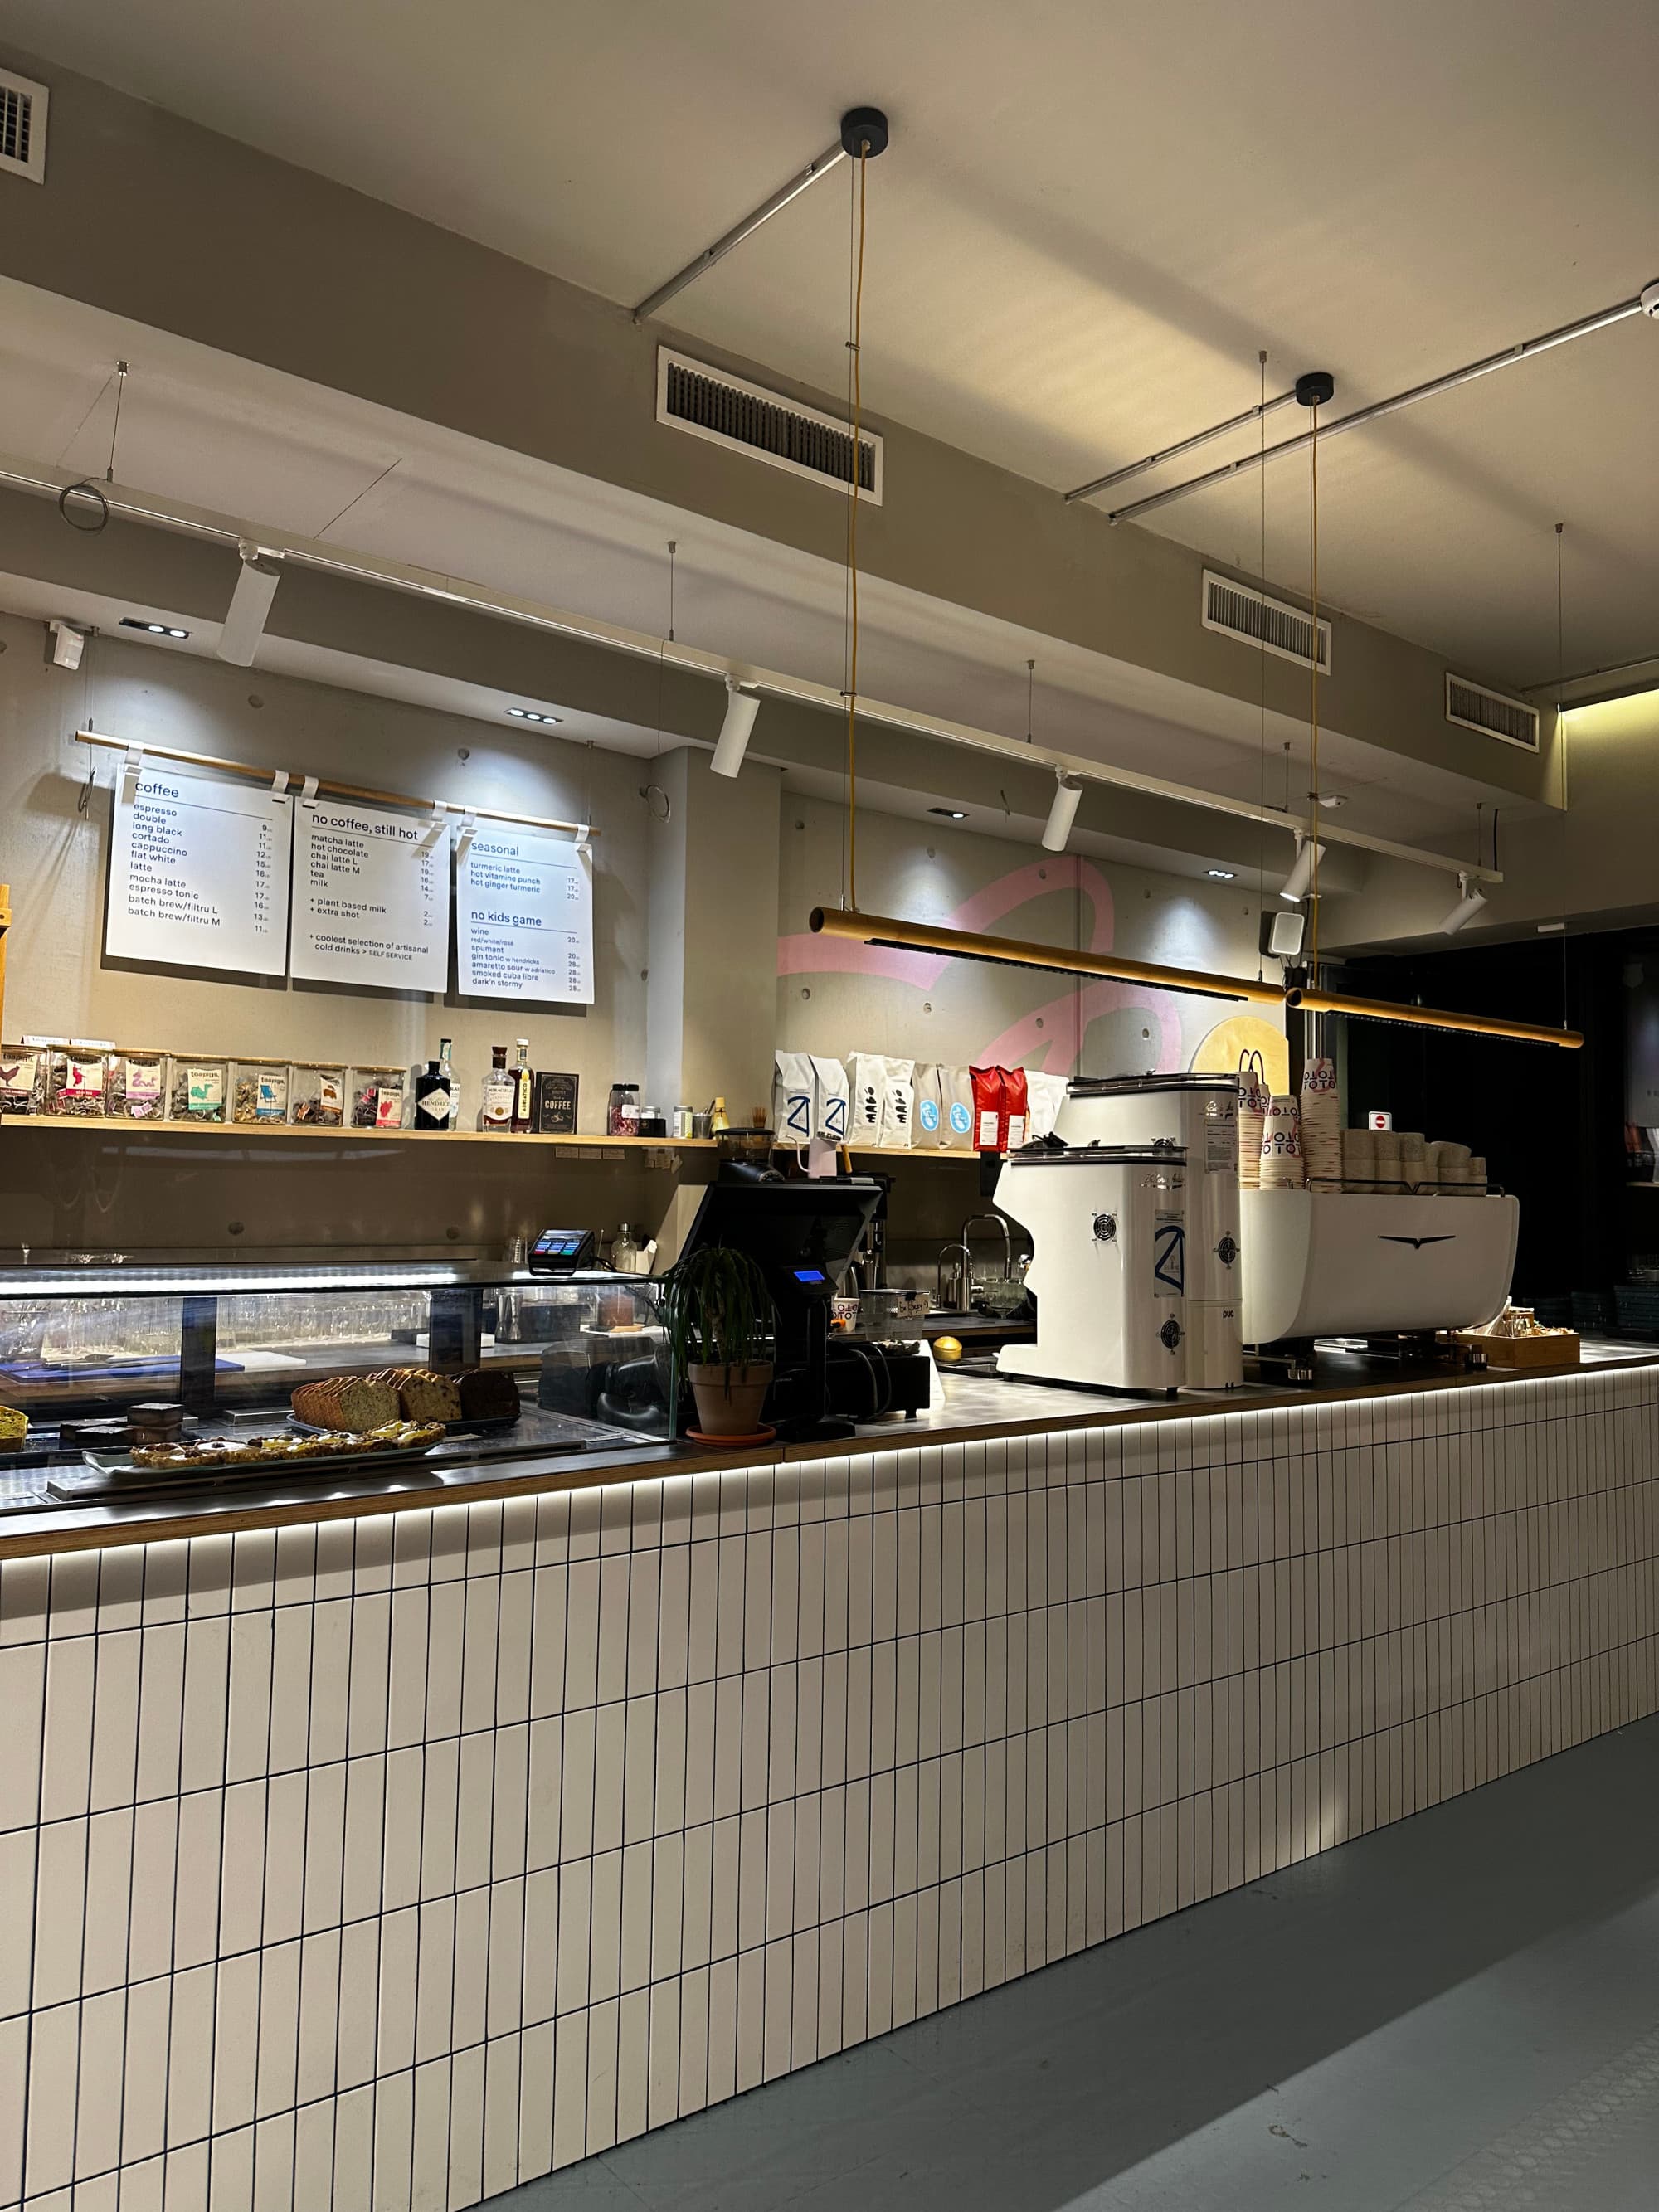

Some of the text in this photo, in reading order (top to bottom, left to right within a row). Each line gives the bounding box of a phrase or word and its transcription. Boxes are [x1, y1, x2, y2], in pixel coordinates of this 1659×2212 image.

[135, 782, 179, 798] coffee
[134, 803, 177, 816] espresso
[133, 812, 166, 824] double
[132, 821, 153, 834] long
[157, 825, 182, 836] black
[312, 814, 418, 840] no coffee, still hot
[132, 831, 169, 843] cortado
[312, 834, 343, 845] matcha
[345, 838, 364, 848] latte
[131, 842, 187, 856] cappuccino
[311, 843, 325, 852] hot
[327, 845, 369, 858] chocolate
[471, 842, 519, 856] seasonal
[131, 850, 147, 860] flat
[149, 853, 176, 864] white
[311, 852, 328, 861] chai
[331, 854, 350, 864] latte
[130, 862, 153, 872] latte
[311, 860, 328, 870] chai
[331, 863, 350, 873] latte
[470, 862, 502, 873] turmeric
[504, 866, 520, 874] latte
[129, 874, 162, 885] mocha
[164, 878, 187, 888] latte
[310, 878, 328, 887] milk
[484, 873, 516, 882] vitamine
[518, 877, 541, 885] punch
[129, 884, 173, 896] espresso
[175, 890, 199, 900] tonic
[484, 880, 508, 890] ginger
[510, 883, 541, 893] turmeric
[129, 895, 156, 906] batch
[158, 898, 209, 914] brew/filtru
[212, 906, 218, 914] L
[317, 897, 339, 907] plant
[342, 900, 367, 911] based
[369, 905, 387, 914] milk
[128, 907, 155, 917] batch
[158, 910, 209, 926] brew/filtru
[212, 918, 221, 926] M
[317, 907, 338, 916] extra
[471, 911, 542, 926] no kids game
[471, 927, 489, 936] wine
[315, 934, 346, 944] coolest
[348, 937, 383, 948] selection
[385, 941, 394, 950] of
[396, 943, 429, 954] artisanal
[471, 945, 504, 954] spumant
[315, 942, 333, 951] cold
[334, 945, 360, 955] drinks
[386, 952, 412, 960] SERVICE
[485, 954, 504, 962] tonic
[472, 961, 505, 970] amaretto
[472, 970, 502, 979] smoked
[504, 971, 521, 980] cuba
[497, 980, 523, 989] stormy
[544, 1100, 572, 1110] COFFEE
